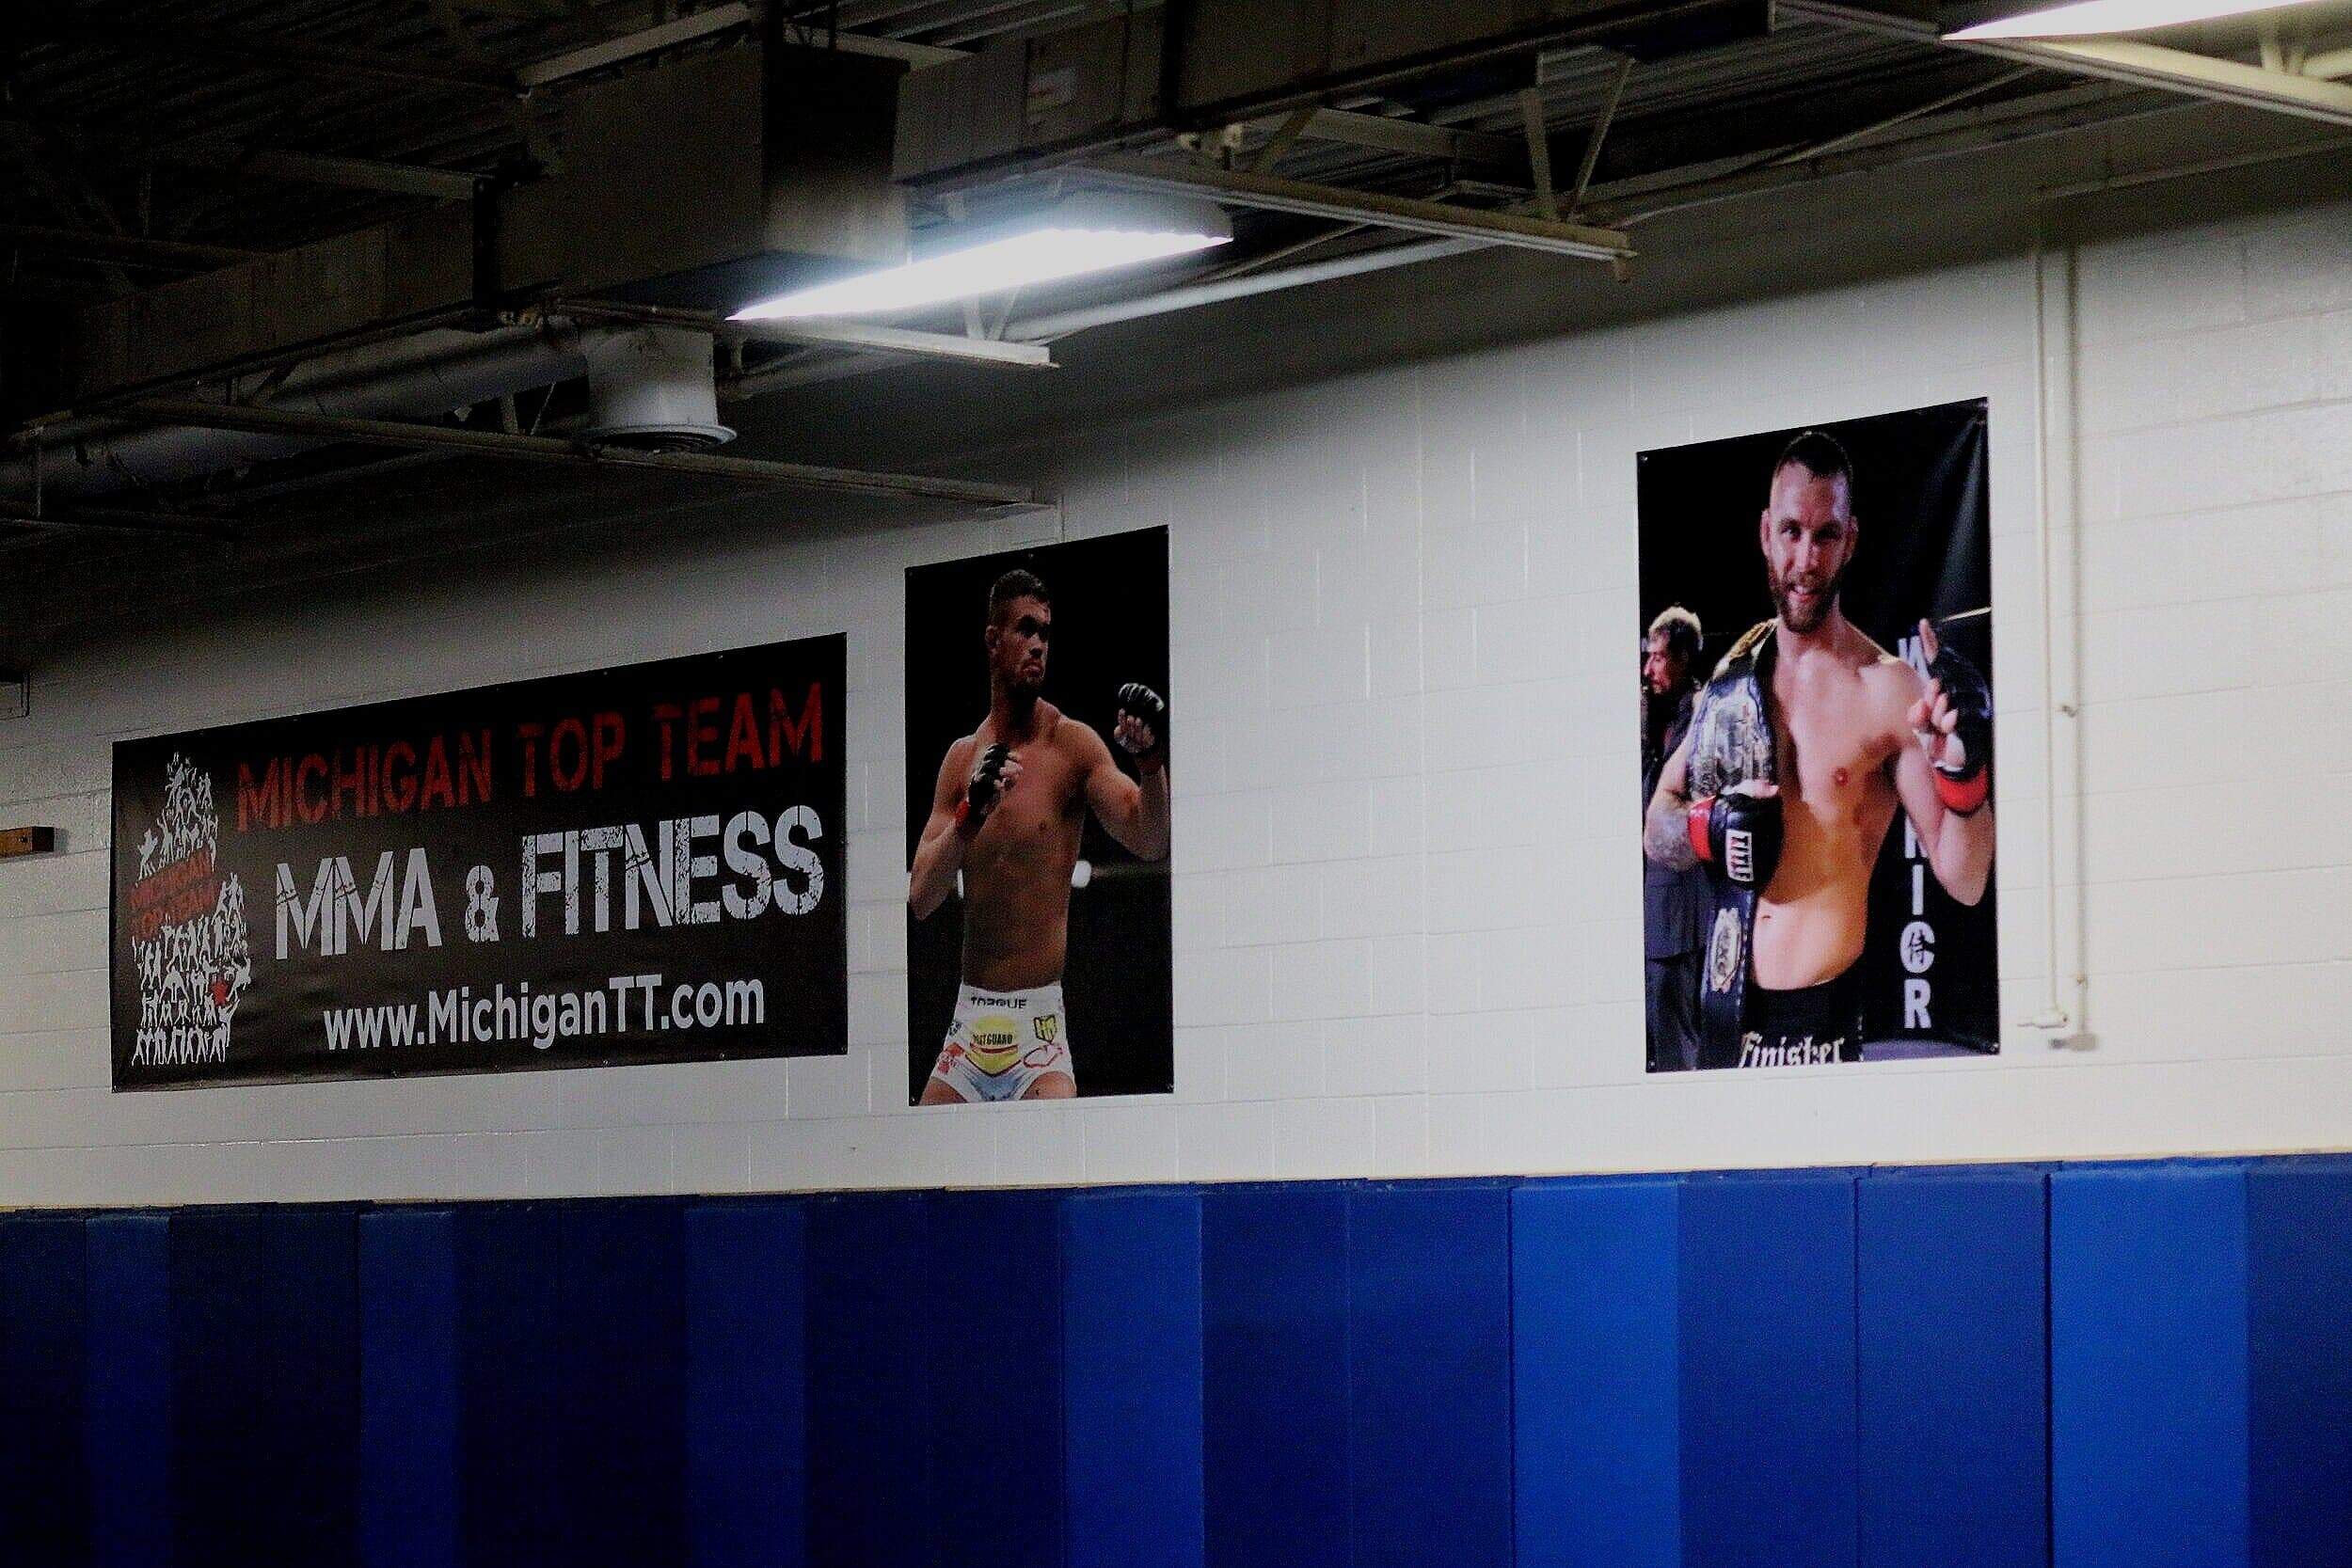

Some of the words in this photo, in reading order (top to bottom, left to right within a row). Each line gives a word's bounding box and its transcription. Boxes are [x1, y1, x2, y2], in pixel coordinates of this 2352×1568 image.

[235, 729, 493, 832] MICHIGAN
[516, 710, 626, 798] TOP
[650, 682, 824, 782] TEAM
[275, 847, 442, 959] MMA
[464, 864, 500, 942] &
[521, 804, 825, 939] FITNESS
[1730, 835, 1751, 879] TITLE
[323, 973, 765, 1052] www.MichiganTT.com
